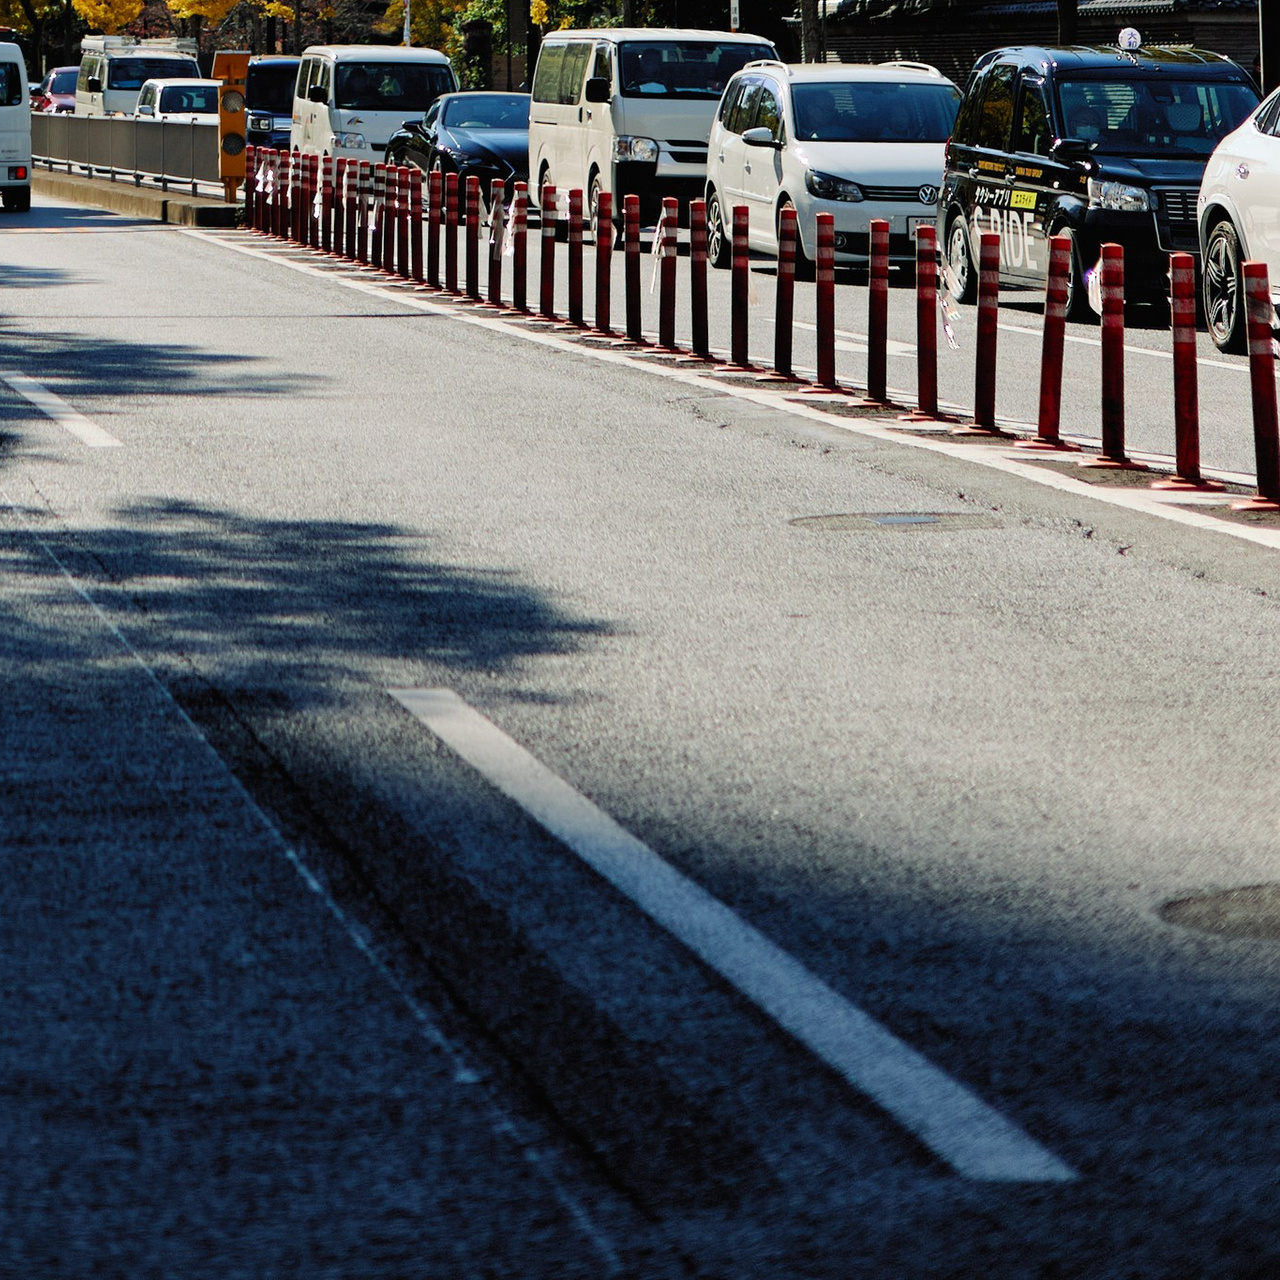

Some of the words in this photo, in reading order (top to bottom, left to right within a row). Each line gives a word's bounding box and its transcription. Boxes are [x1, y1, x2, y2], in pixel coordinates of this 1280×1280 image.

[1128, 32, 1137, 48] 大和
[974, 185, 1010, 206] タクシーアプリ
